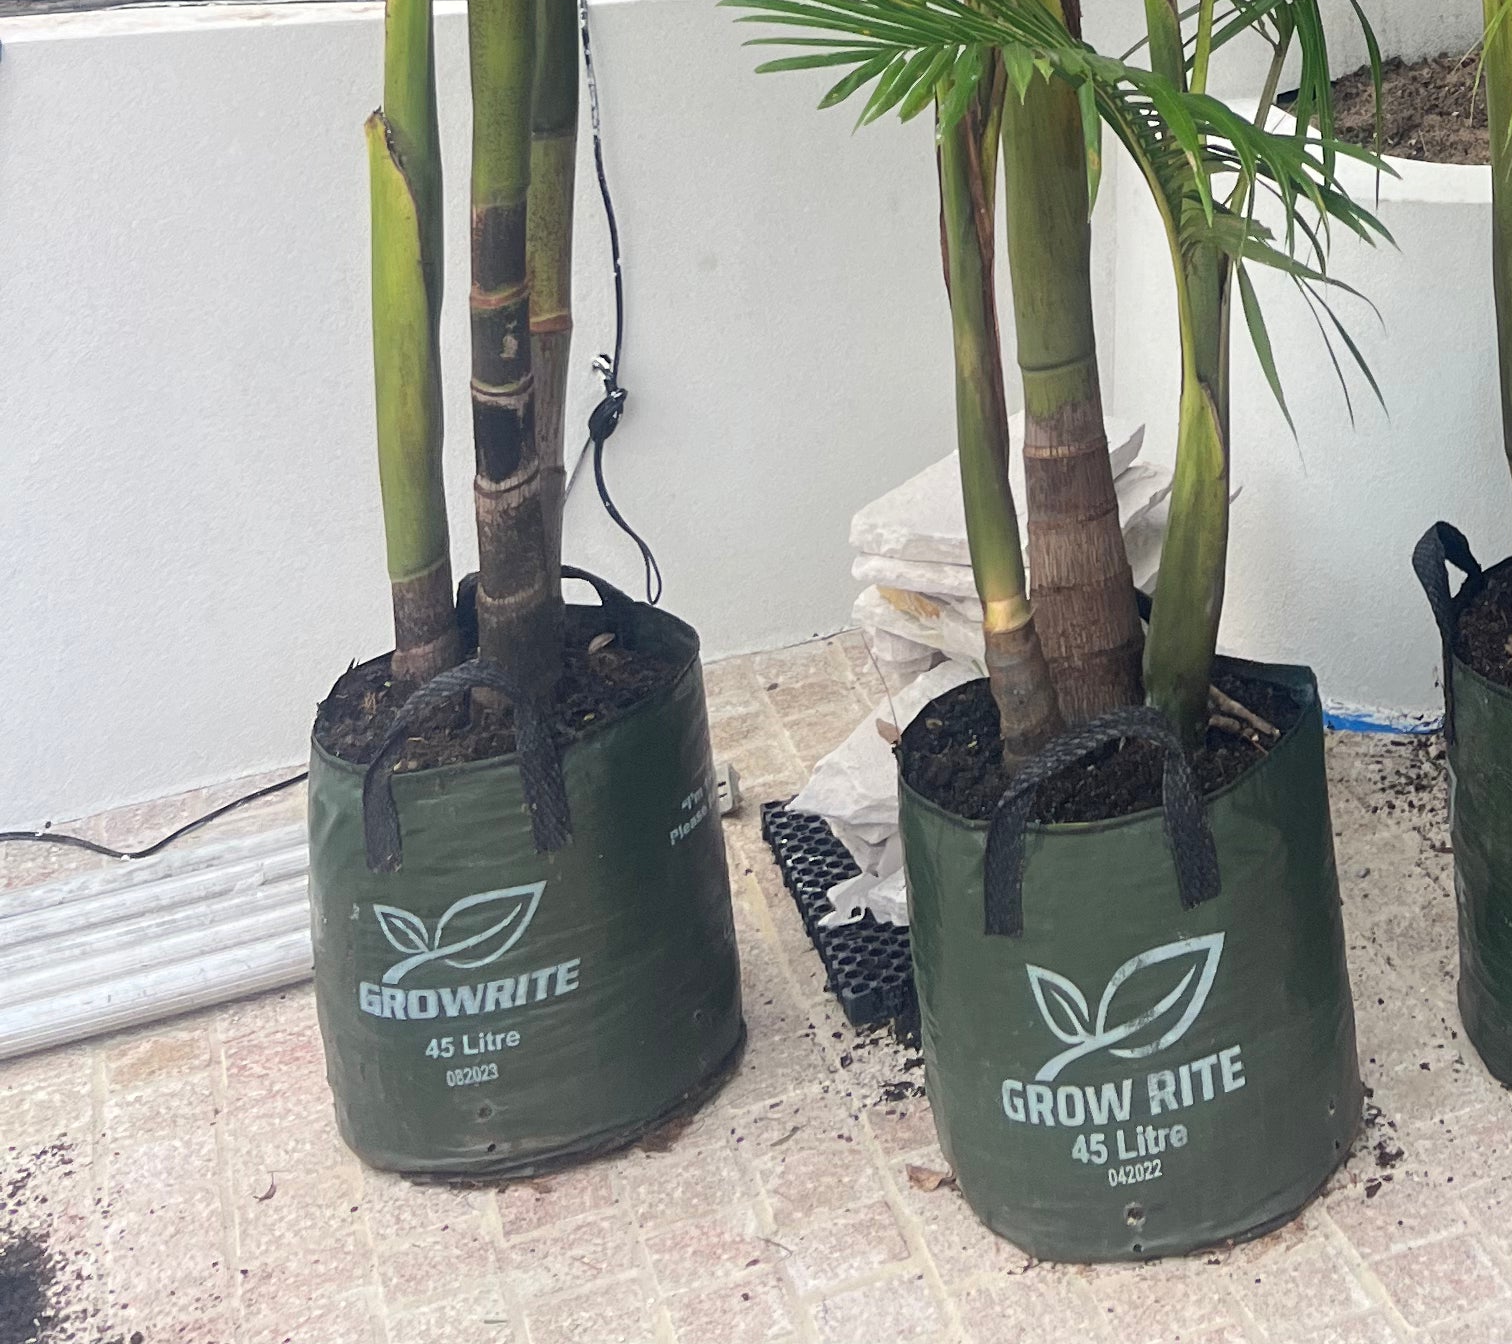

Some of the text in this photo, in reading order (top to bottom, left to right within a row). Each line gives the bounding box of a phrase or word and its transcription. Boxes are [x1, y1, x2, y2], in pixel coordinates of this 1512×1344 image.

[359, 957, 582, 1020] GROWRITE
[425, 1030, 521, 1059] 45 Litre
[446, 1063, 500, 1087] 082023
[1001, 1044, 1246, 1127] GROW RITE
[1071, 1124, 1189, 1164] 45 Litre
[1108, 1159, 1163, 1187] 042022
